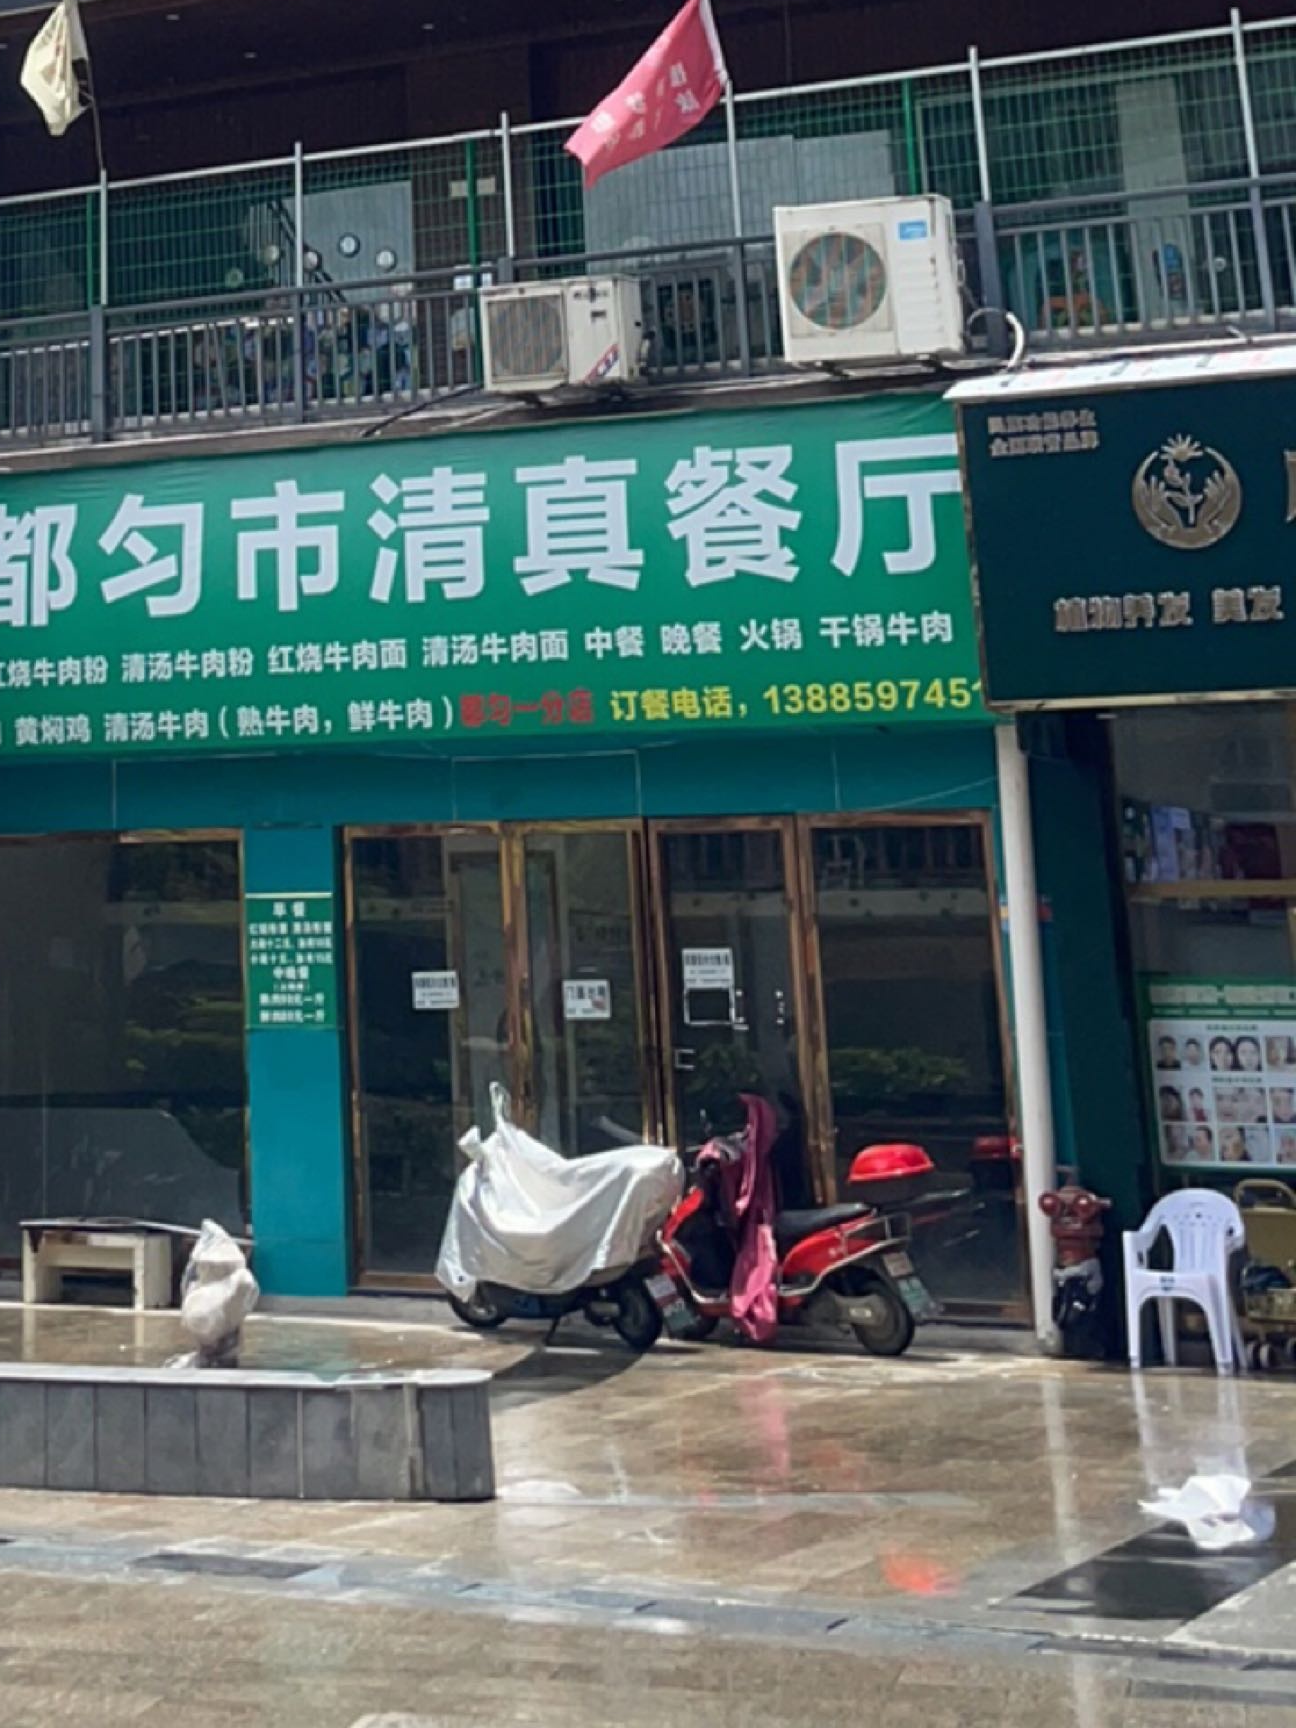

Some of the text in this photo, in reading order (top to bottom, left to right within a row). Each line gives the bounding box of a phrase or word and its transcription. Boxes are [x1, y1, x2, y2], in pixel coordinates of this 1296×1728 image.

[121, 648, 254, 683] 清汤牛肉粉
[268, 638, 407, 675] 红烧牛肉面
[423, 629, 568, 667] 清汤牛肉面
[584, 625, 645, 659] 中餐
[660, 621, 722, 655] 晚餐
[739, 617, 802, 652] 火锅
[820, 610, 954, 649] 干锅牛肉
[764, 678, 985, 715] 138859745
